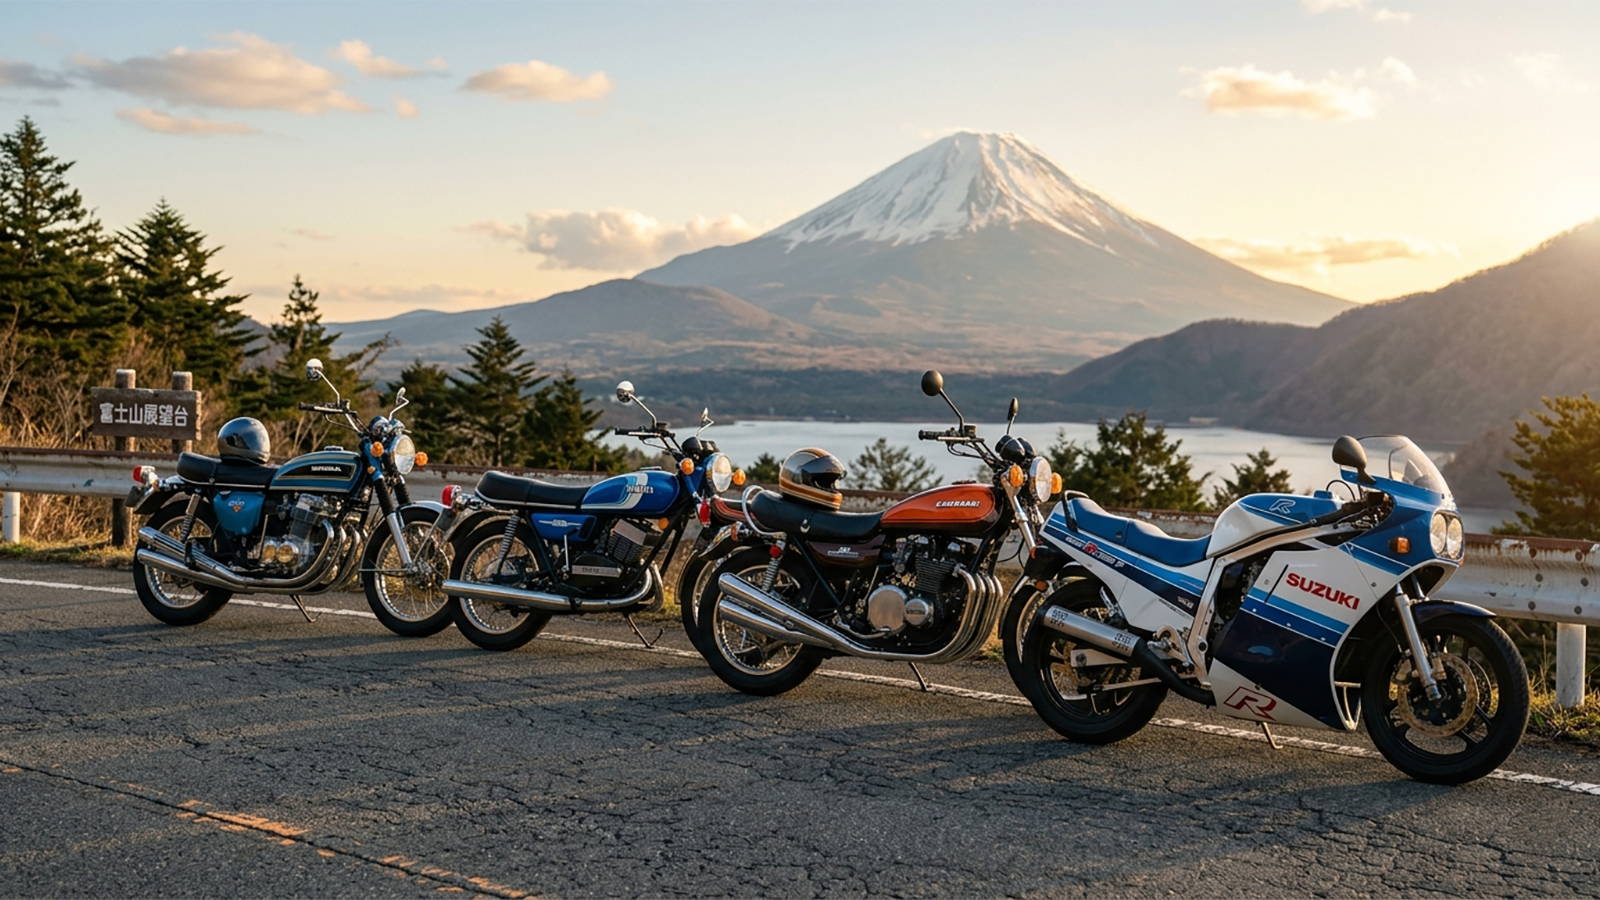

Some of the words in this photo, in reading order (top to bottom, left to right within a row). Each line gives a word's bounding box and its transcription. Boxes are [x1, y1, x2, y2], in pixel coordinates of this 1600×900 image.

[99, 402, 188, 426] 富士山展望台
[1286, 572, 1360, 610] SUZUKI
[1223, 686, 1277, 721] R
